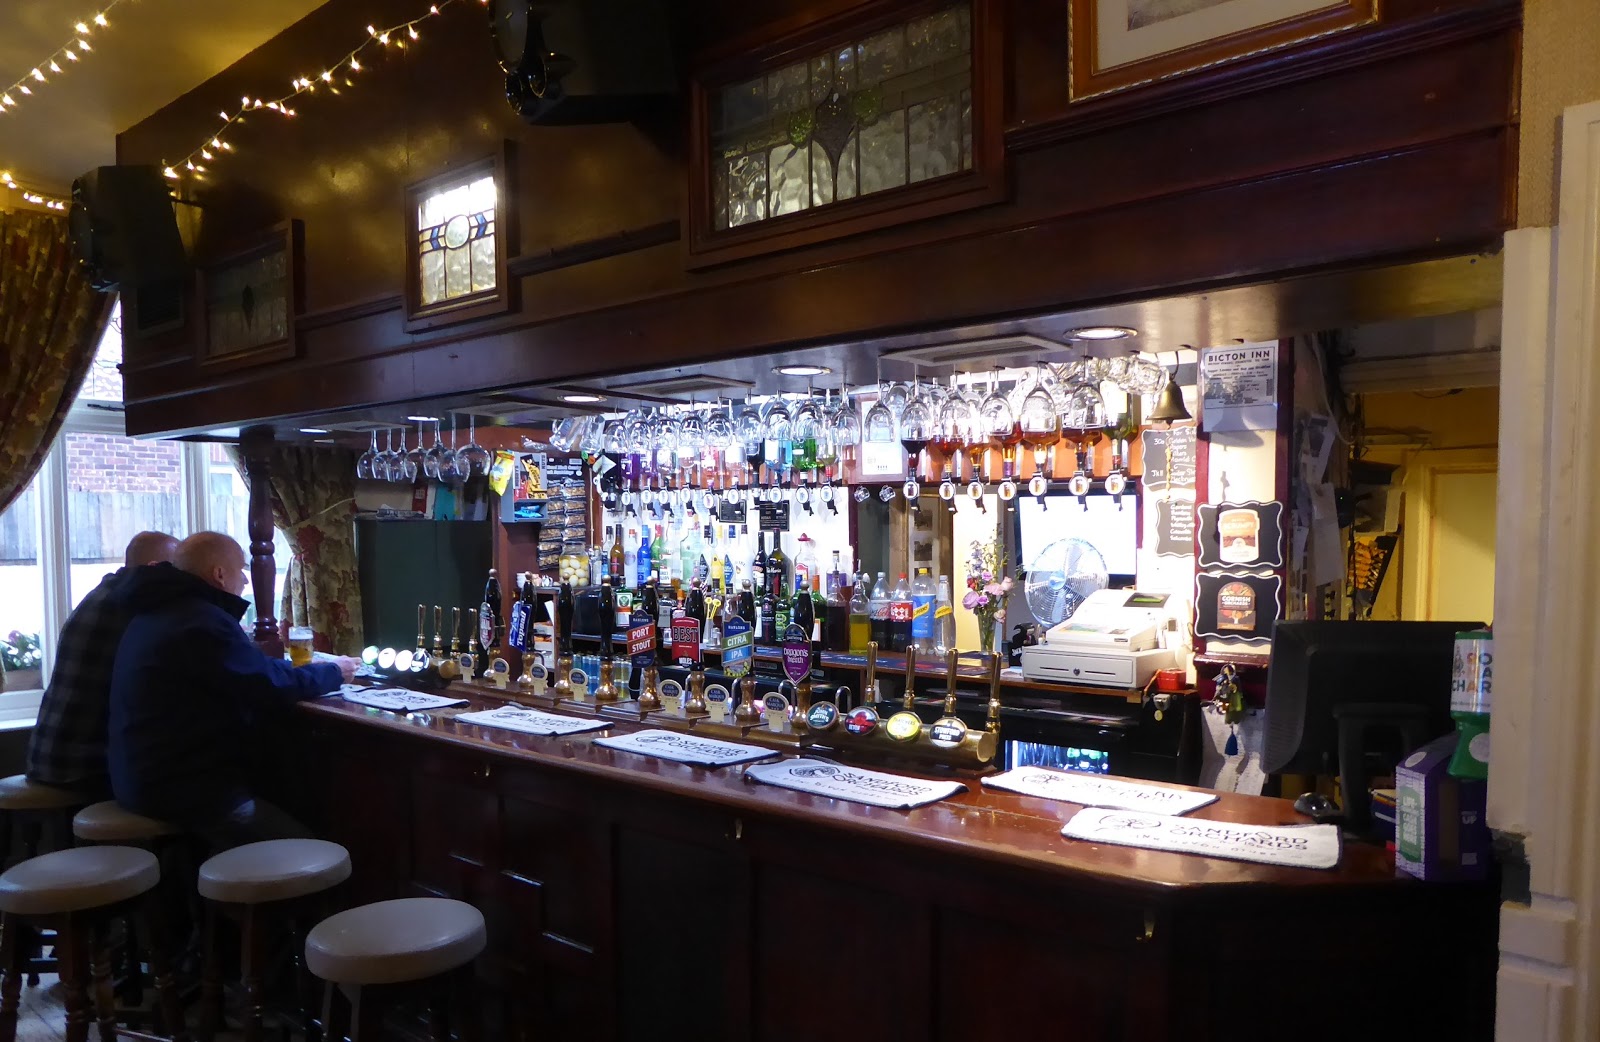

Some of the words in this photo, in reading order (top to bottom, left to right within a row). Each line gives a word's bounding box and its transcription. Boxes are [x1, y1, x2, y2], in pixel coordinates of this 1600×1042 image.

[1208, 352, 1246, 362] BICTON
[1251, 350, 1270, 358] INN
[632, 626, 650, 640] PORT
[672, 626, 698, 643] BEST
[632, 640, 651, 653] STOUT
[727, 635, 747, 647] CITRA
[731, 649, 743, 659] IPA
[832, 774, 924, 796] ORCHARDS
[843, 772, 933, 793] SANDFORD
[1169, 828, 1308, 850] ORCHARDS
[1175, 824, 1309, 844] SANDFORD
